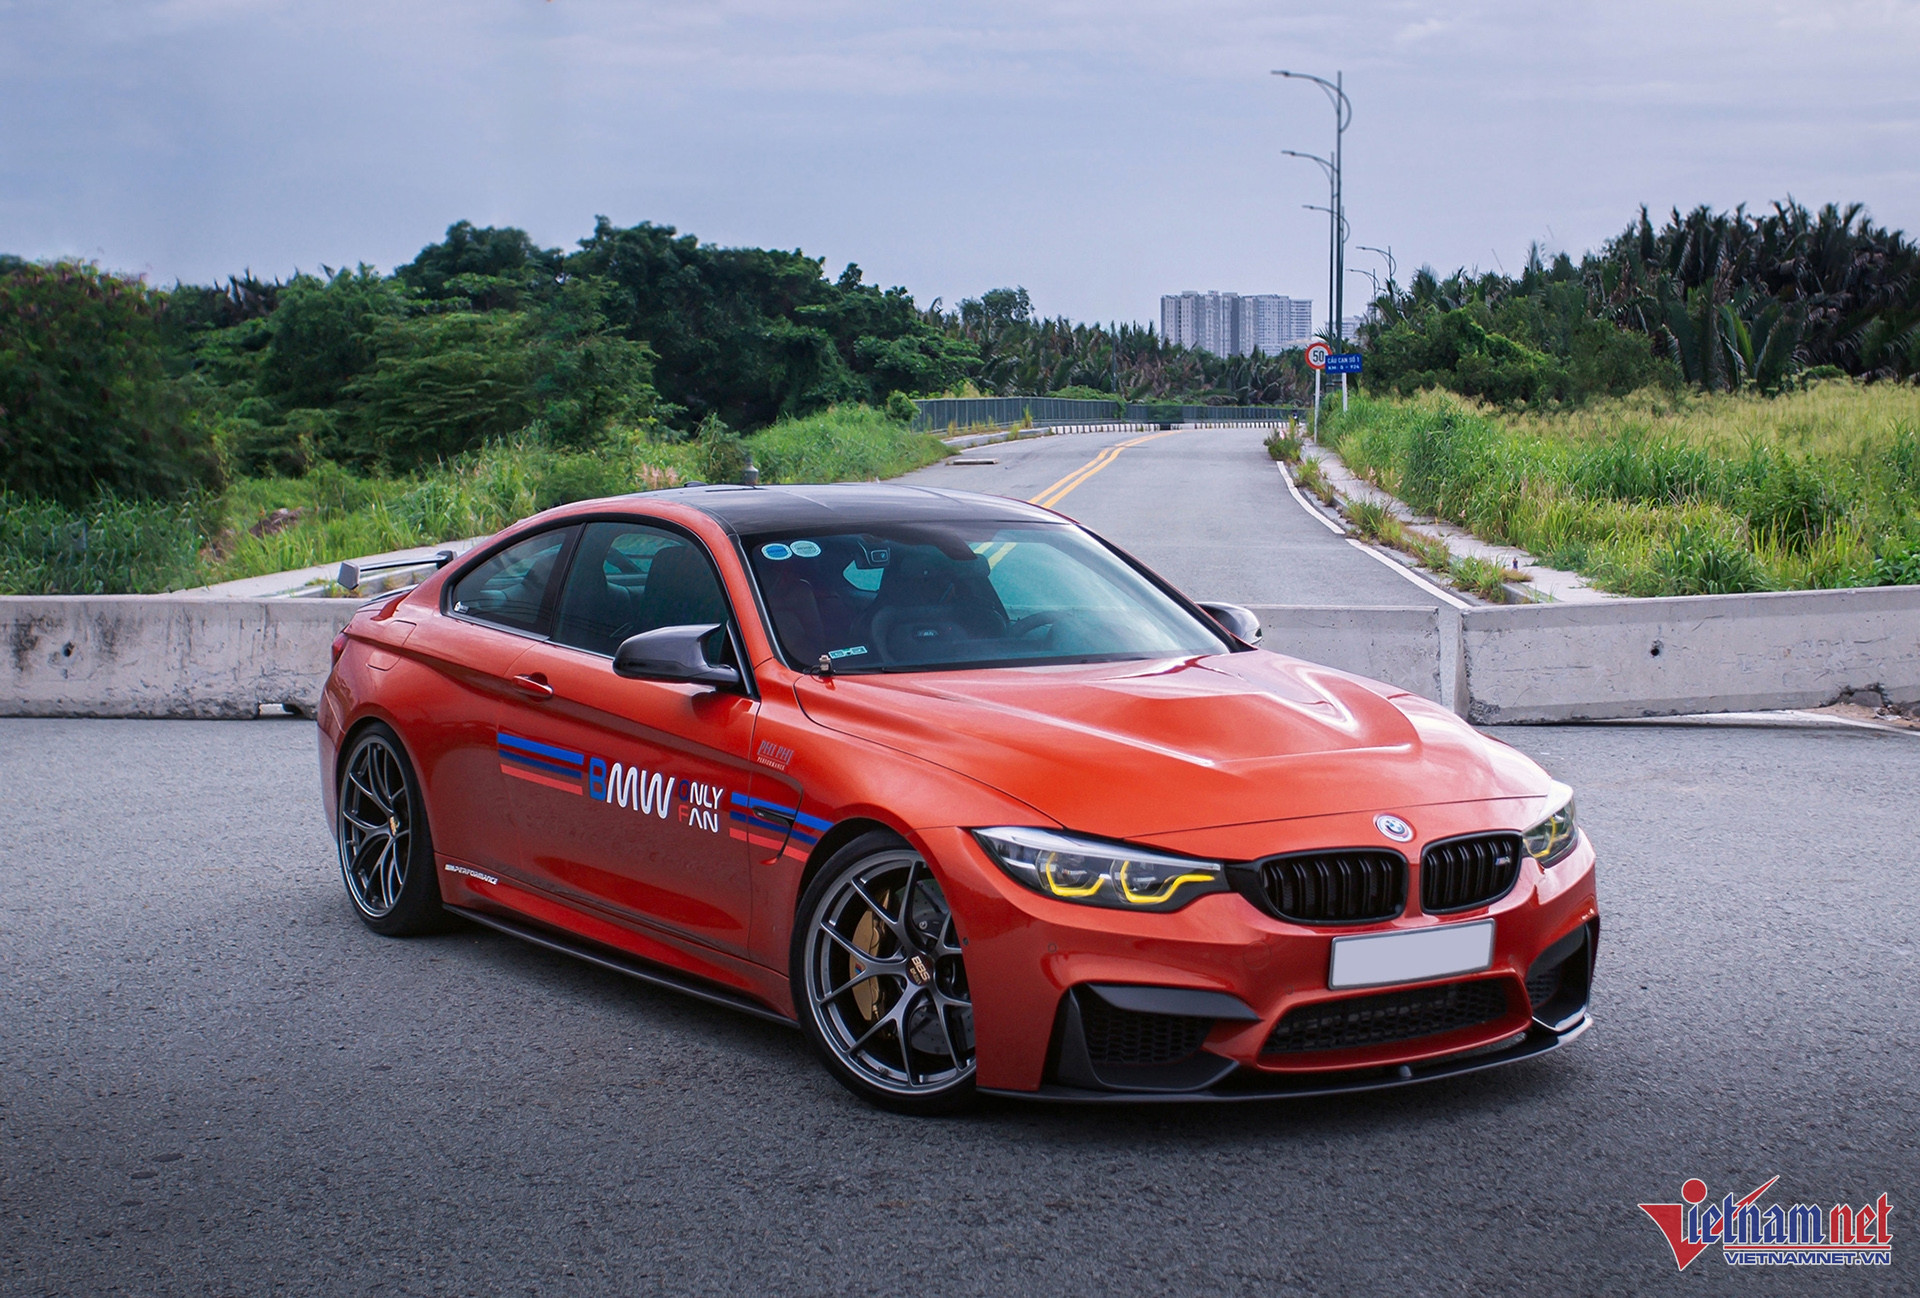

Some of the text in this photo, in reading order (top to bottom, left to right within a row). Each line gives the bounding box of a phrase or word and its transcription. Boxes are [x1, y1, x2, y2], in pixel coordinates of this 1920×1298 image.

[1313, 351, 1324, 362] 50
[589, 757, 723, 819] BMW ONLY
[679, 804, 718, 833] FAN
